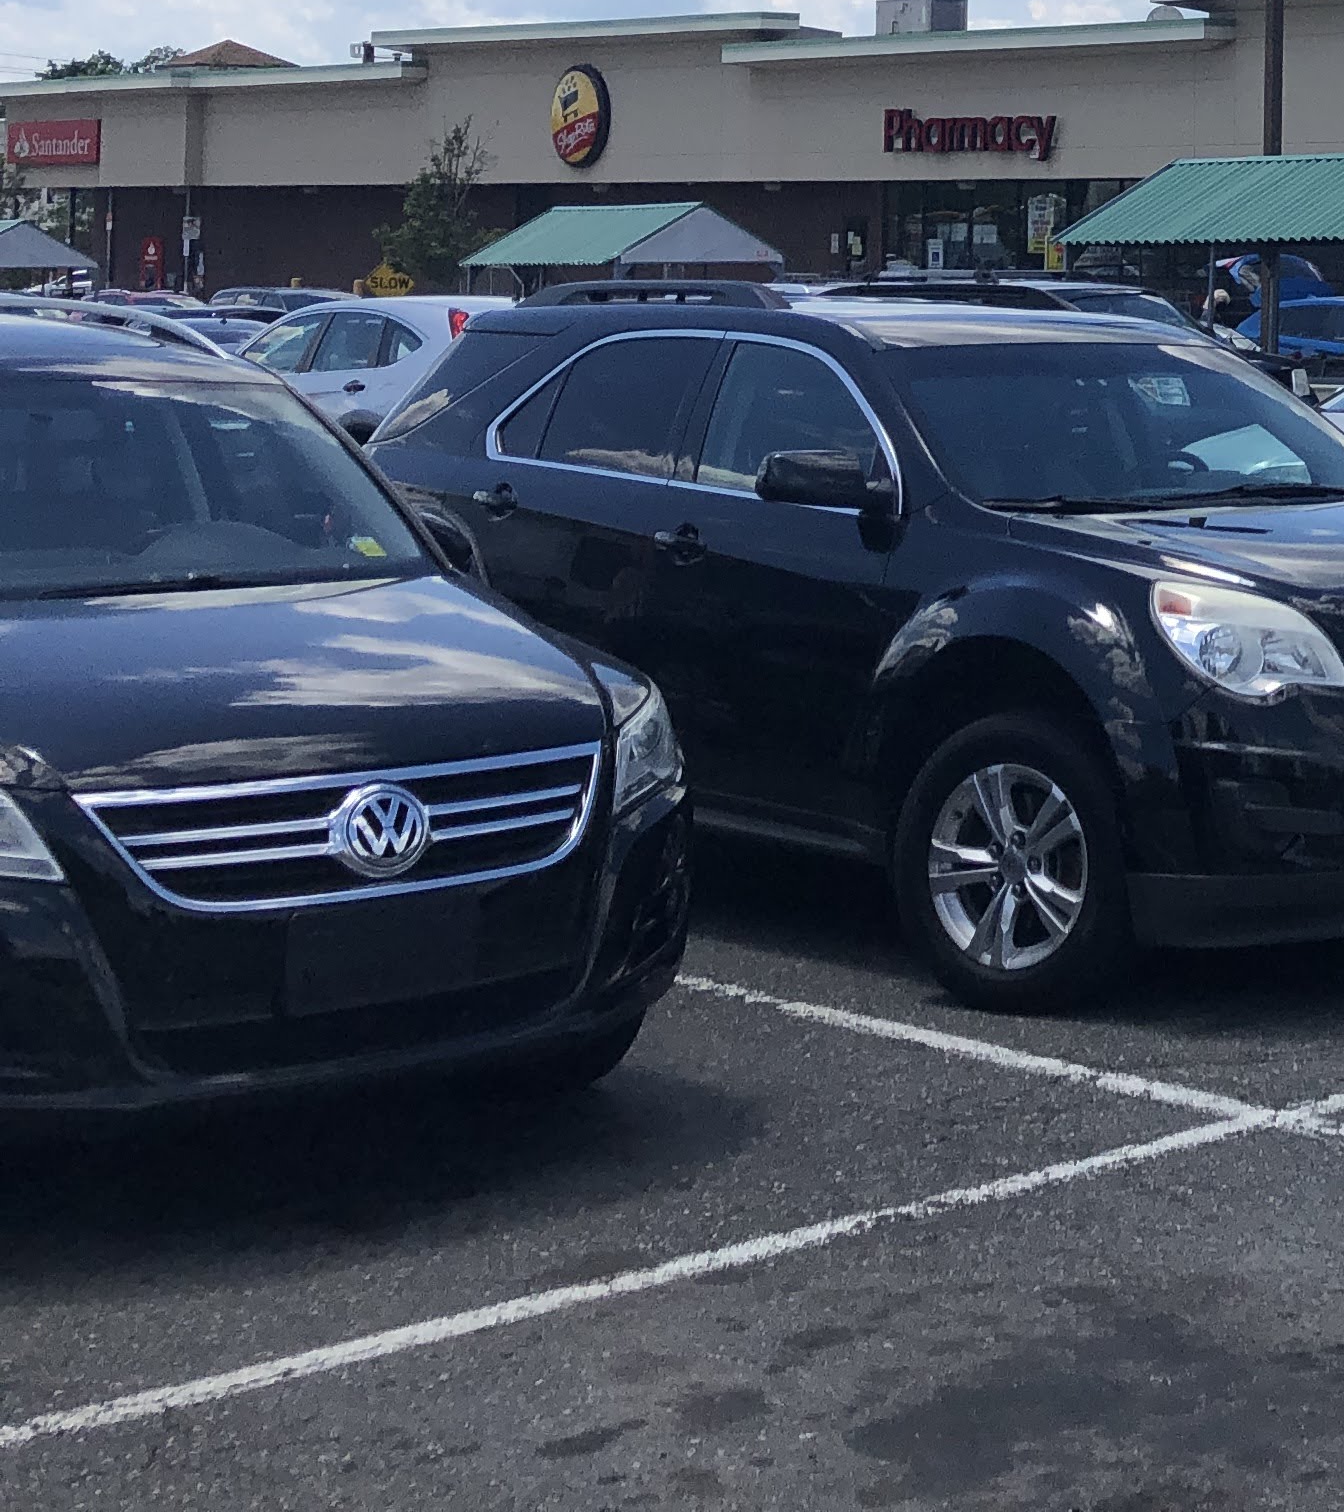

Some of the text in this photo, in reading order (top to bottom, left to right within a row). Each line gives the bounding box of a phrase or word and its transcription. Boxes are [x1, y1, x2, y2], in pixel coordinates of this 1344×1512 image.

[30, 129, 91, 157] Santander
[884, 108, 1057, 161] Pharmacy
[370, 276, 410, 289] SLOW
